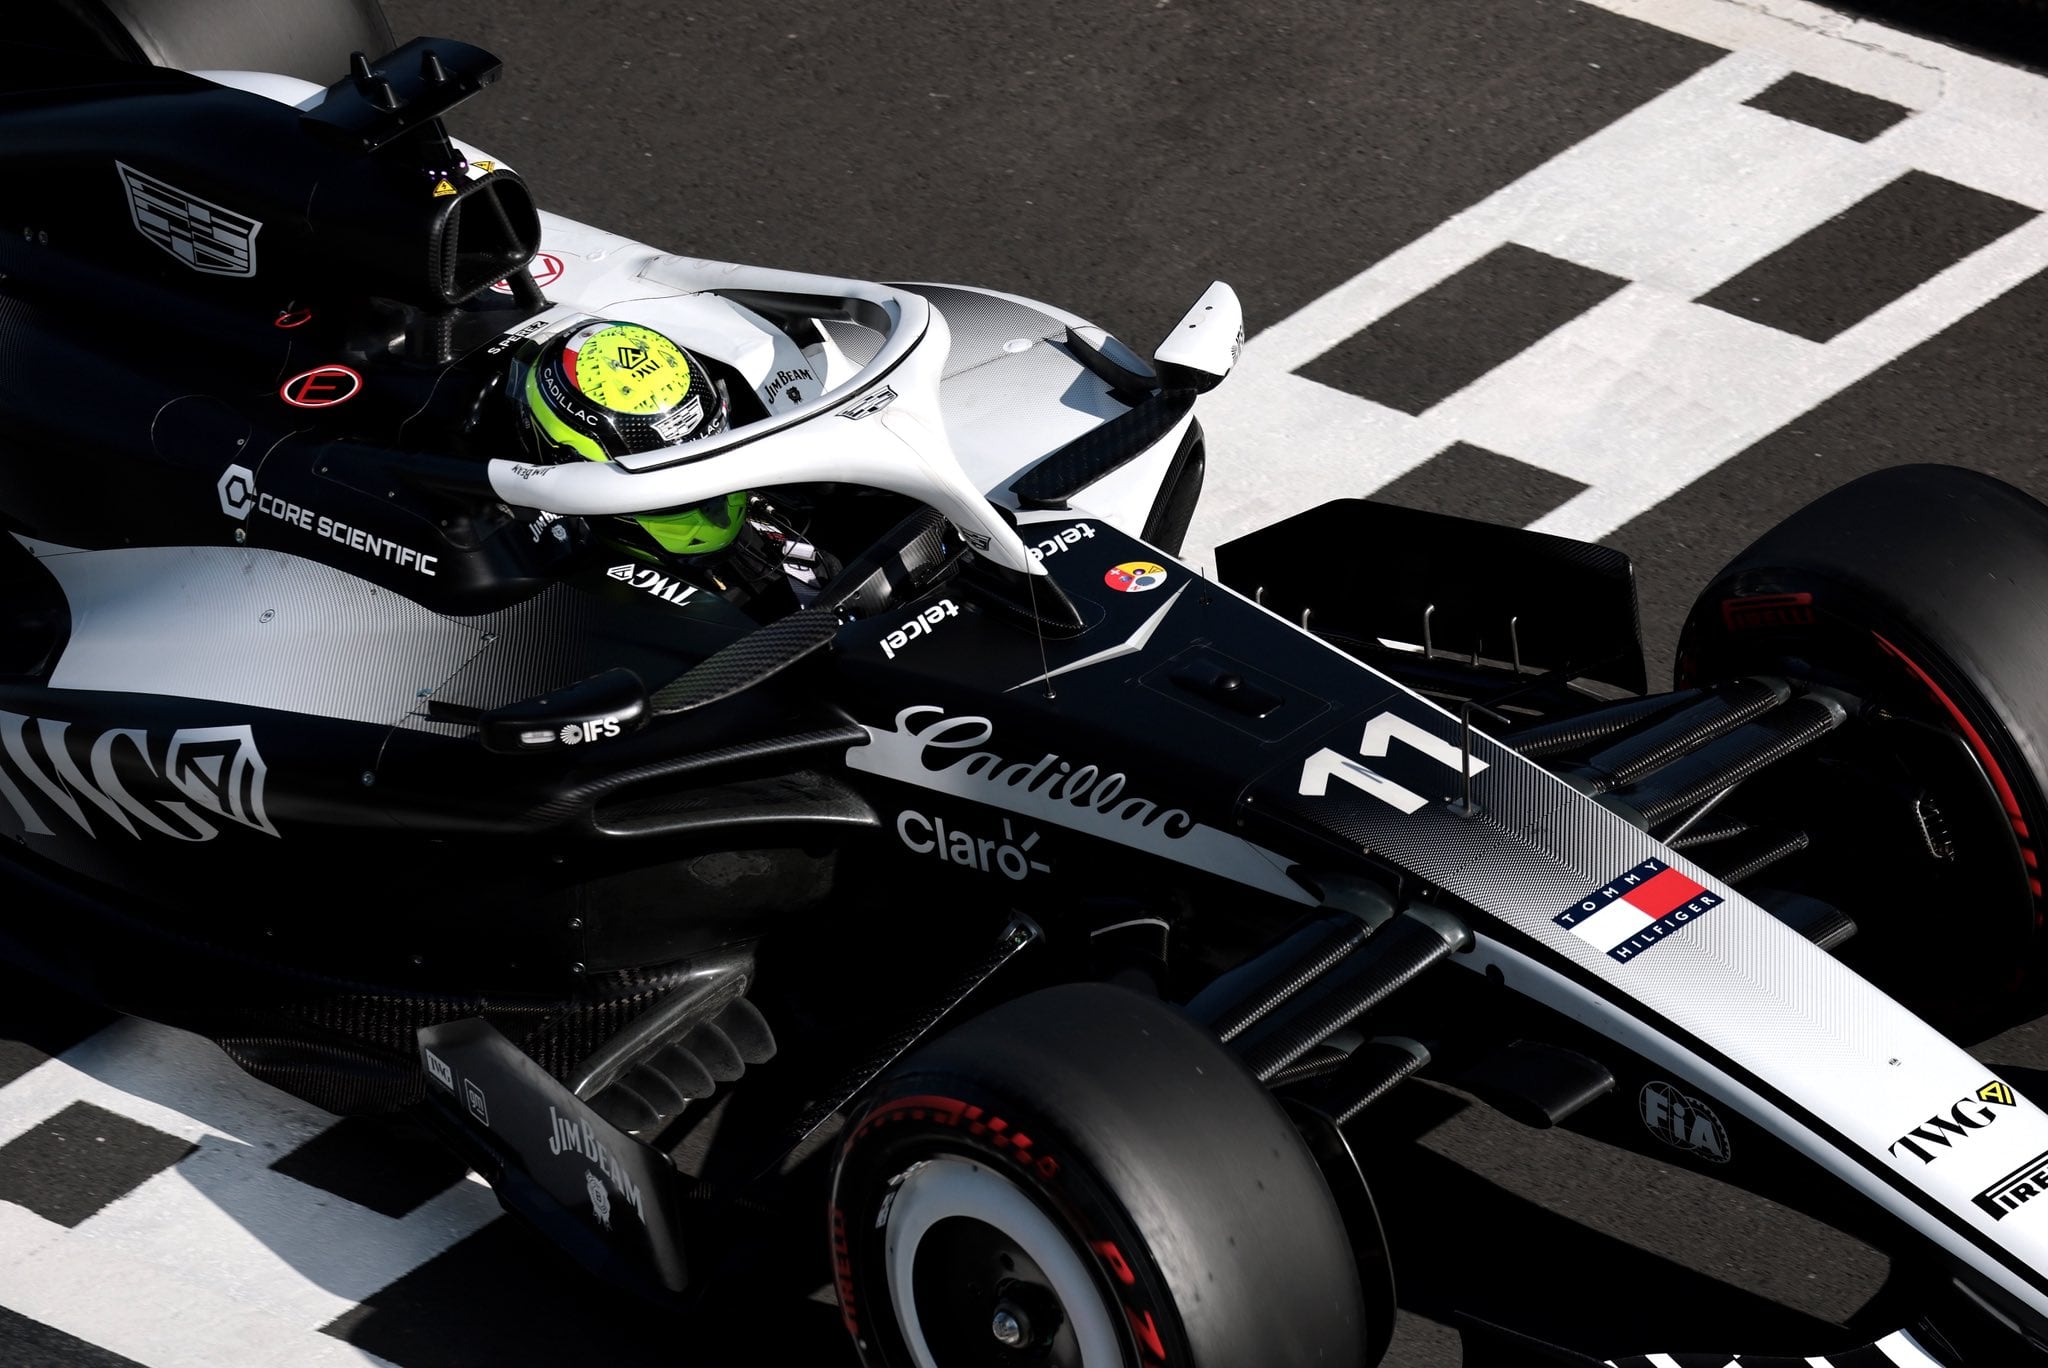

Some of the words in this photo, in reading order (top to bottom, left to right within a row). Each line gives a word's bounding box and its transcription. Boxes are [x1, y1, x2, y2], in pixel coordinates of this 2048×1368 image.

[488, 320, 549, 354] S.PEREZ
[543, 367, 600, 426] CADILLAC
[764, 380, 784, 405] JIM
[776, 368, 814, 388] BEAM
[257, 492, 315, 532] CORE
[316, 516, 439, 577] SCIENTIFIC
[1027, 522, 1097, 563] telce
[626, 568, 700, 607] TWG
[879, 599, 960, 660] telcel
[582, 716, 621, 743] IFS
[894, 705, 1192, 840] Cadillac
[1298, 710, 1491, 815] 11
[896, 809, 1036, 881] Claro
[1561, 861, 1659, 924] TOMMY
[1615, 895, 1716, 958] HILFIGER
[1887, 1096, 1997, 1165] TWG
[549, 1105, 583, 1156] JIM
[579, 1116, 646, 1228] BEAM
[1970, 1150, 2048, 1222] PIRE
